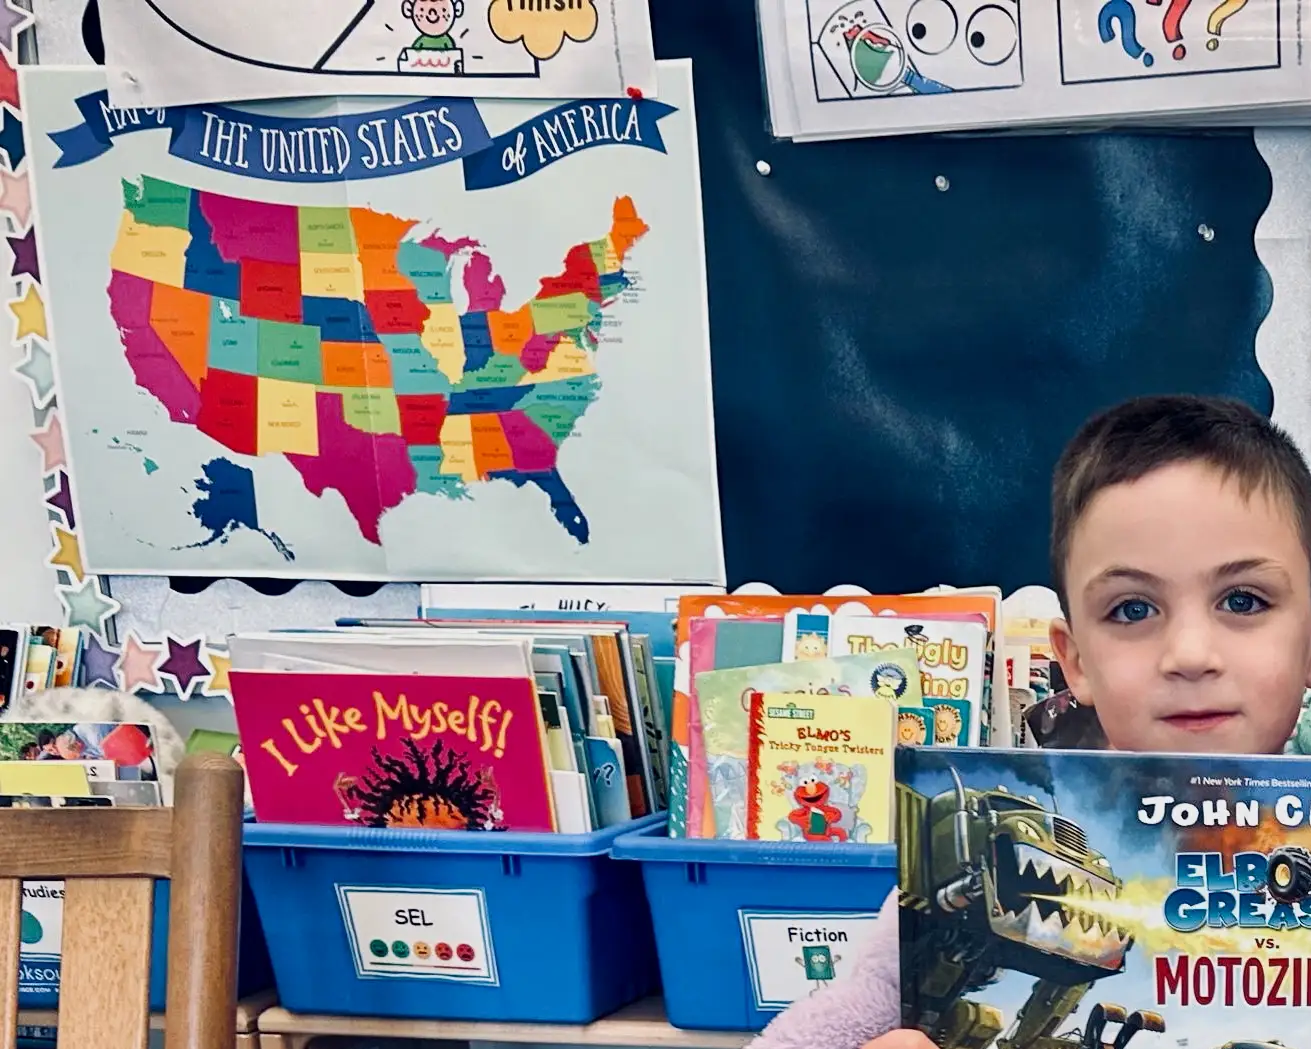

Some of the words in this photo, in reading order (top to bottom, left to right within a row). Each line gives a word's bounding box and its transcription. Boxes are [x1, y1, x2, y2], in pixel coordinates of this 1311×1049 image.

[201, 111, 252, 168] THE
[260, 126, 351, 175] UNITED
[357, 107, 463, 169] STATES
[501, 132, 527, 176] of
[532, 103, 642, 163] AMERICA
[260, 738, 298, 776] I
[282, 698, 367, 754] Like
[372, 691, 513, 758] Myself!
[797, 726, 852, 742] ELMO'S
[769, 741, 802, 752] Tricky
[805, 743, 840, 754] Tongue
[843, 744, 884, 755] Twisters
[1190, 776, 1201, 785] #1
[1203, 777, 1222, 785] New
[1224, 778, 1242, 786] York
[1244, 778, 1270, 787] Times
[1137, 796, 1259, 827] JOHN
[395, 908, 433, 926] SEL
[787, 927, 848, 942] Fiction
